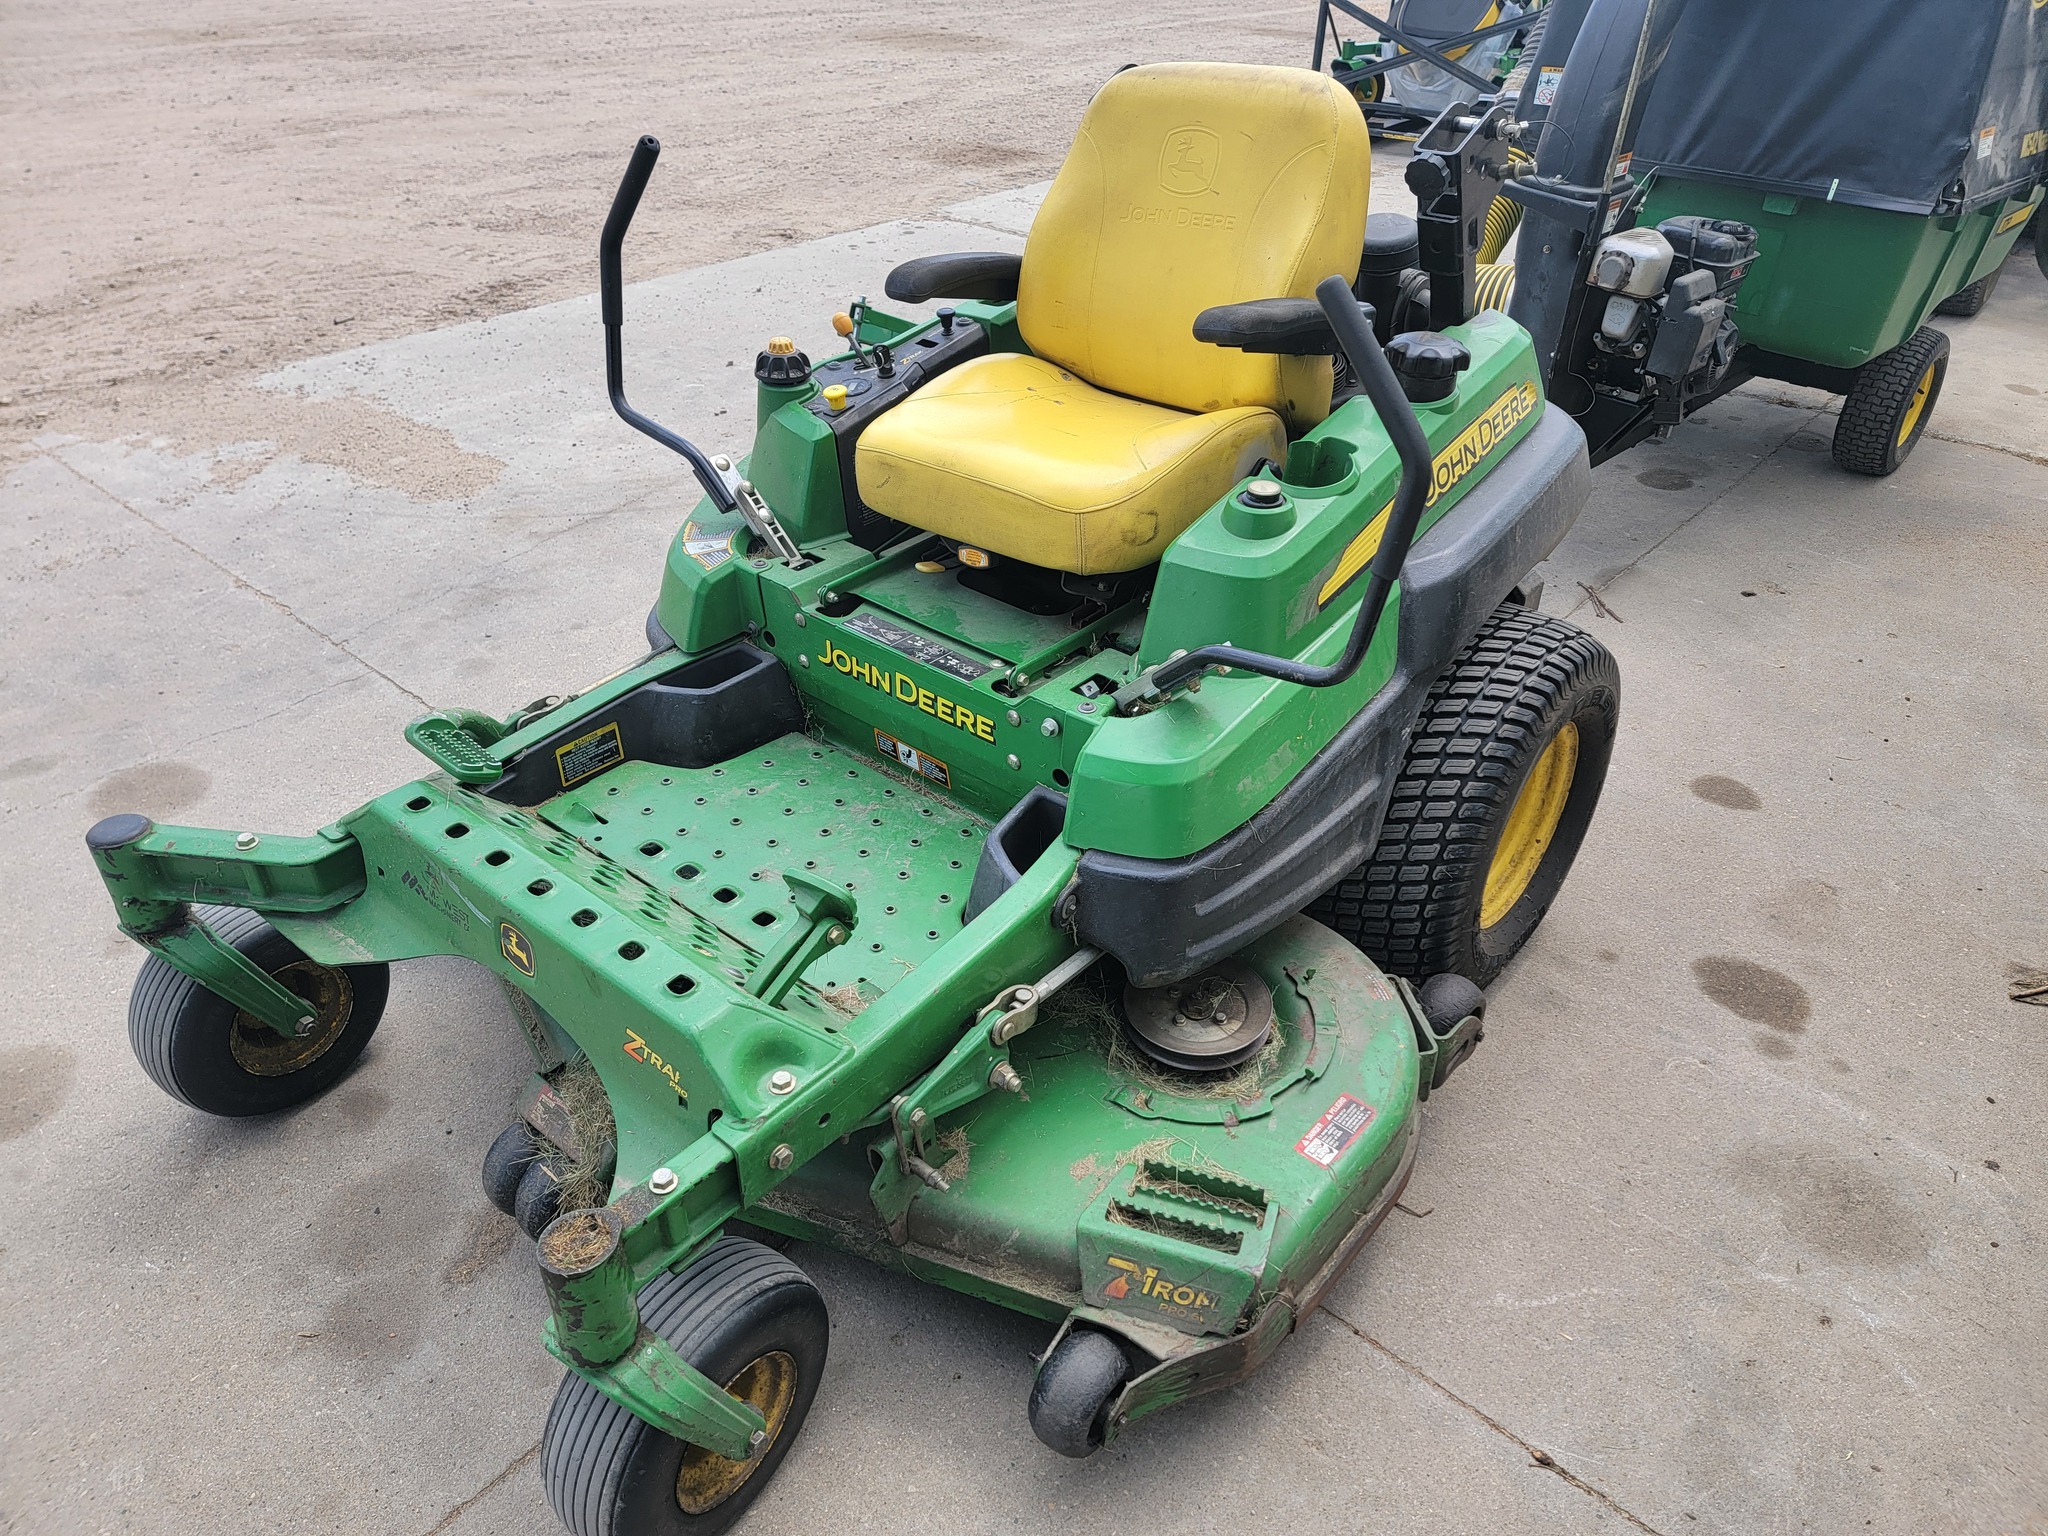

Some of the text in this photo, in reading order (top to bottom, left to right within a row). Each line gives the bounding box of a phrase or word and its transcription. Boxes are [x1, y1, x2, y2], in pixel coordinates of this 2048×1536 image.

[1120, 202, 1237, 232] JOHN DEERE
[1478, 385, 1530, 453] DEERE
[817, 639, 892, 695] JOHN
[895, 671, 997, 745] DEERE
[669, 1080, 688, 1098] PRO
[1158, 1303, 1188, 1318] PRO
